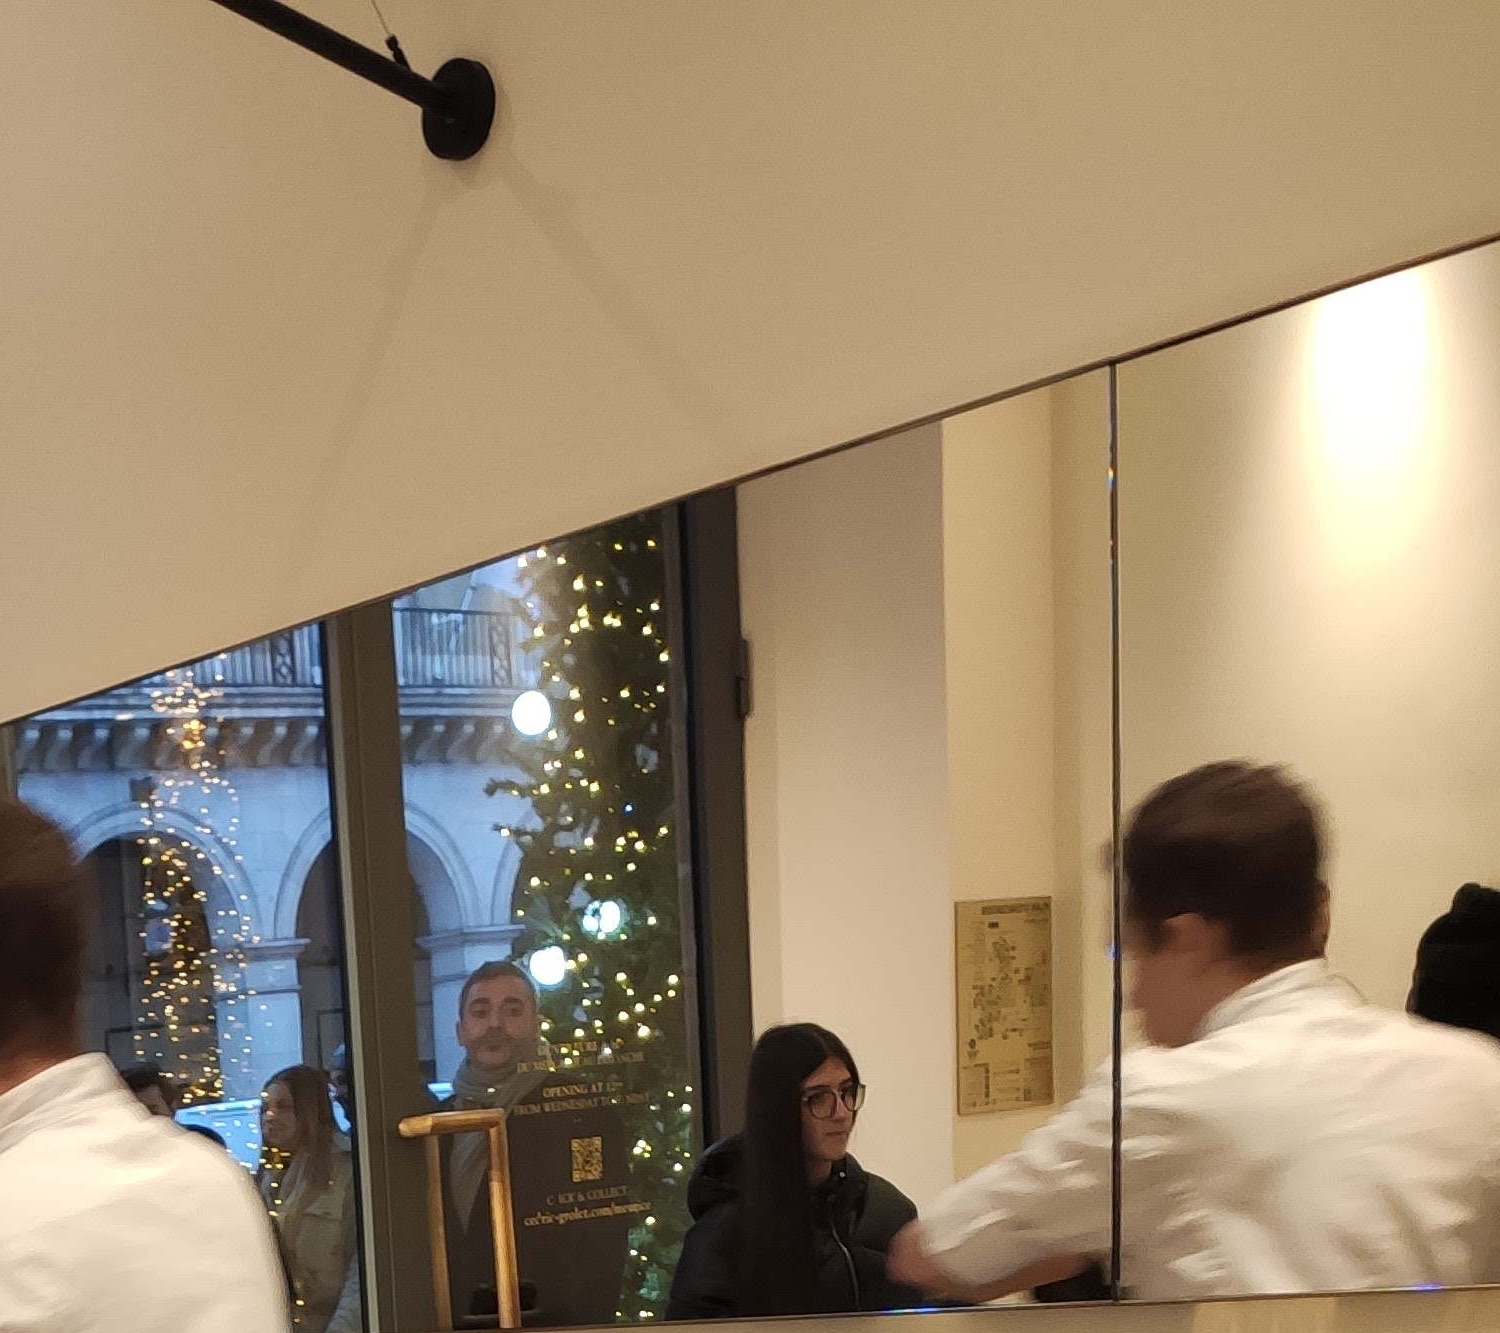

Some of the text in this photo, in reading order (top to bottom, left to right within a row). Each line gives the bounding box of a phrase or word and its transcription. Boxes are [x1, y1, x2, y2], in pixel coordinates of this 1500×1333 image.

[543, 1083, 588, 1098] OPENING
[546, 1190, 574, 1205] CICK
[587, 1185, 629, 1201] COLLECT
